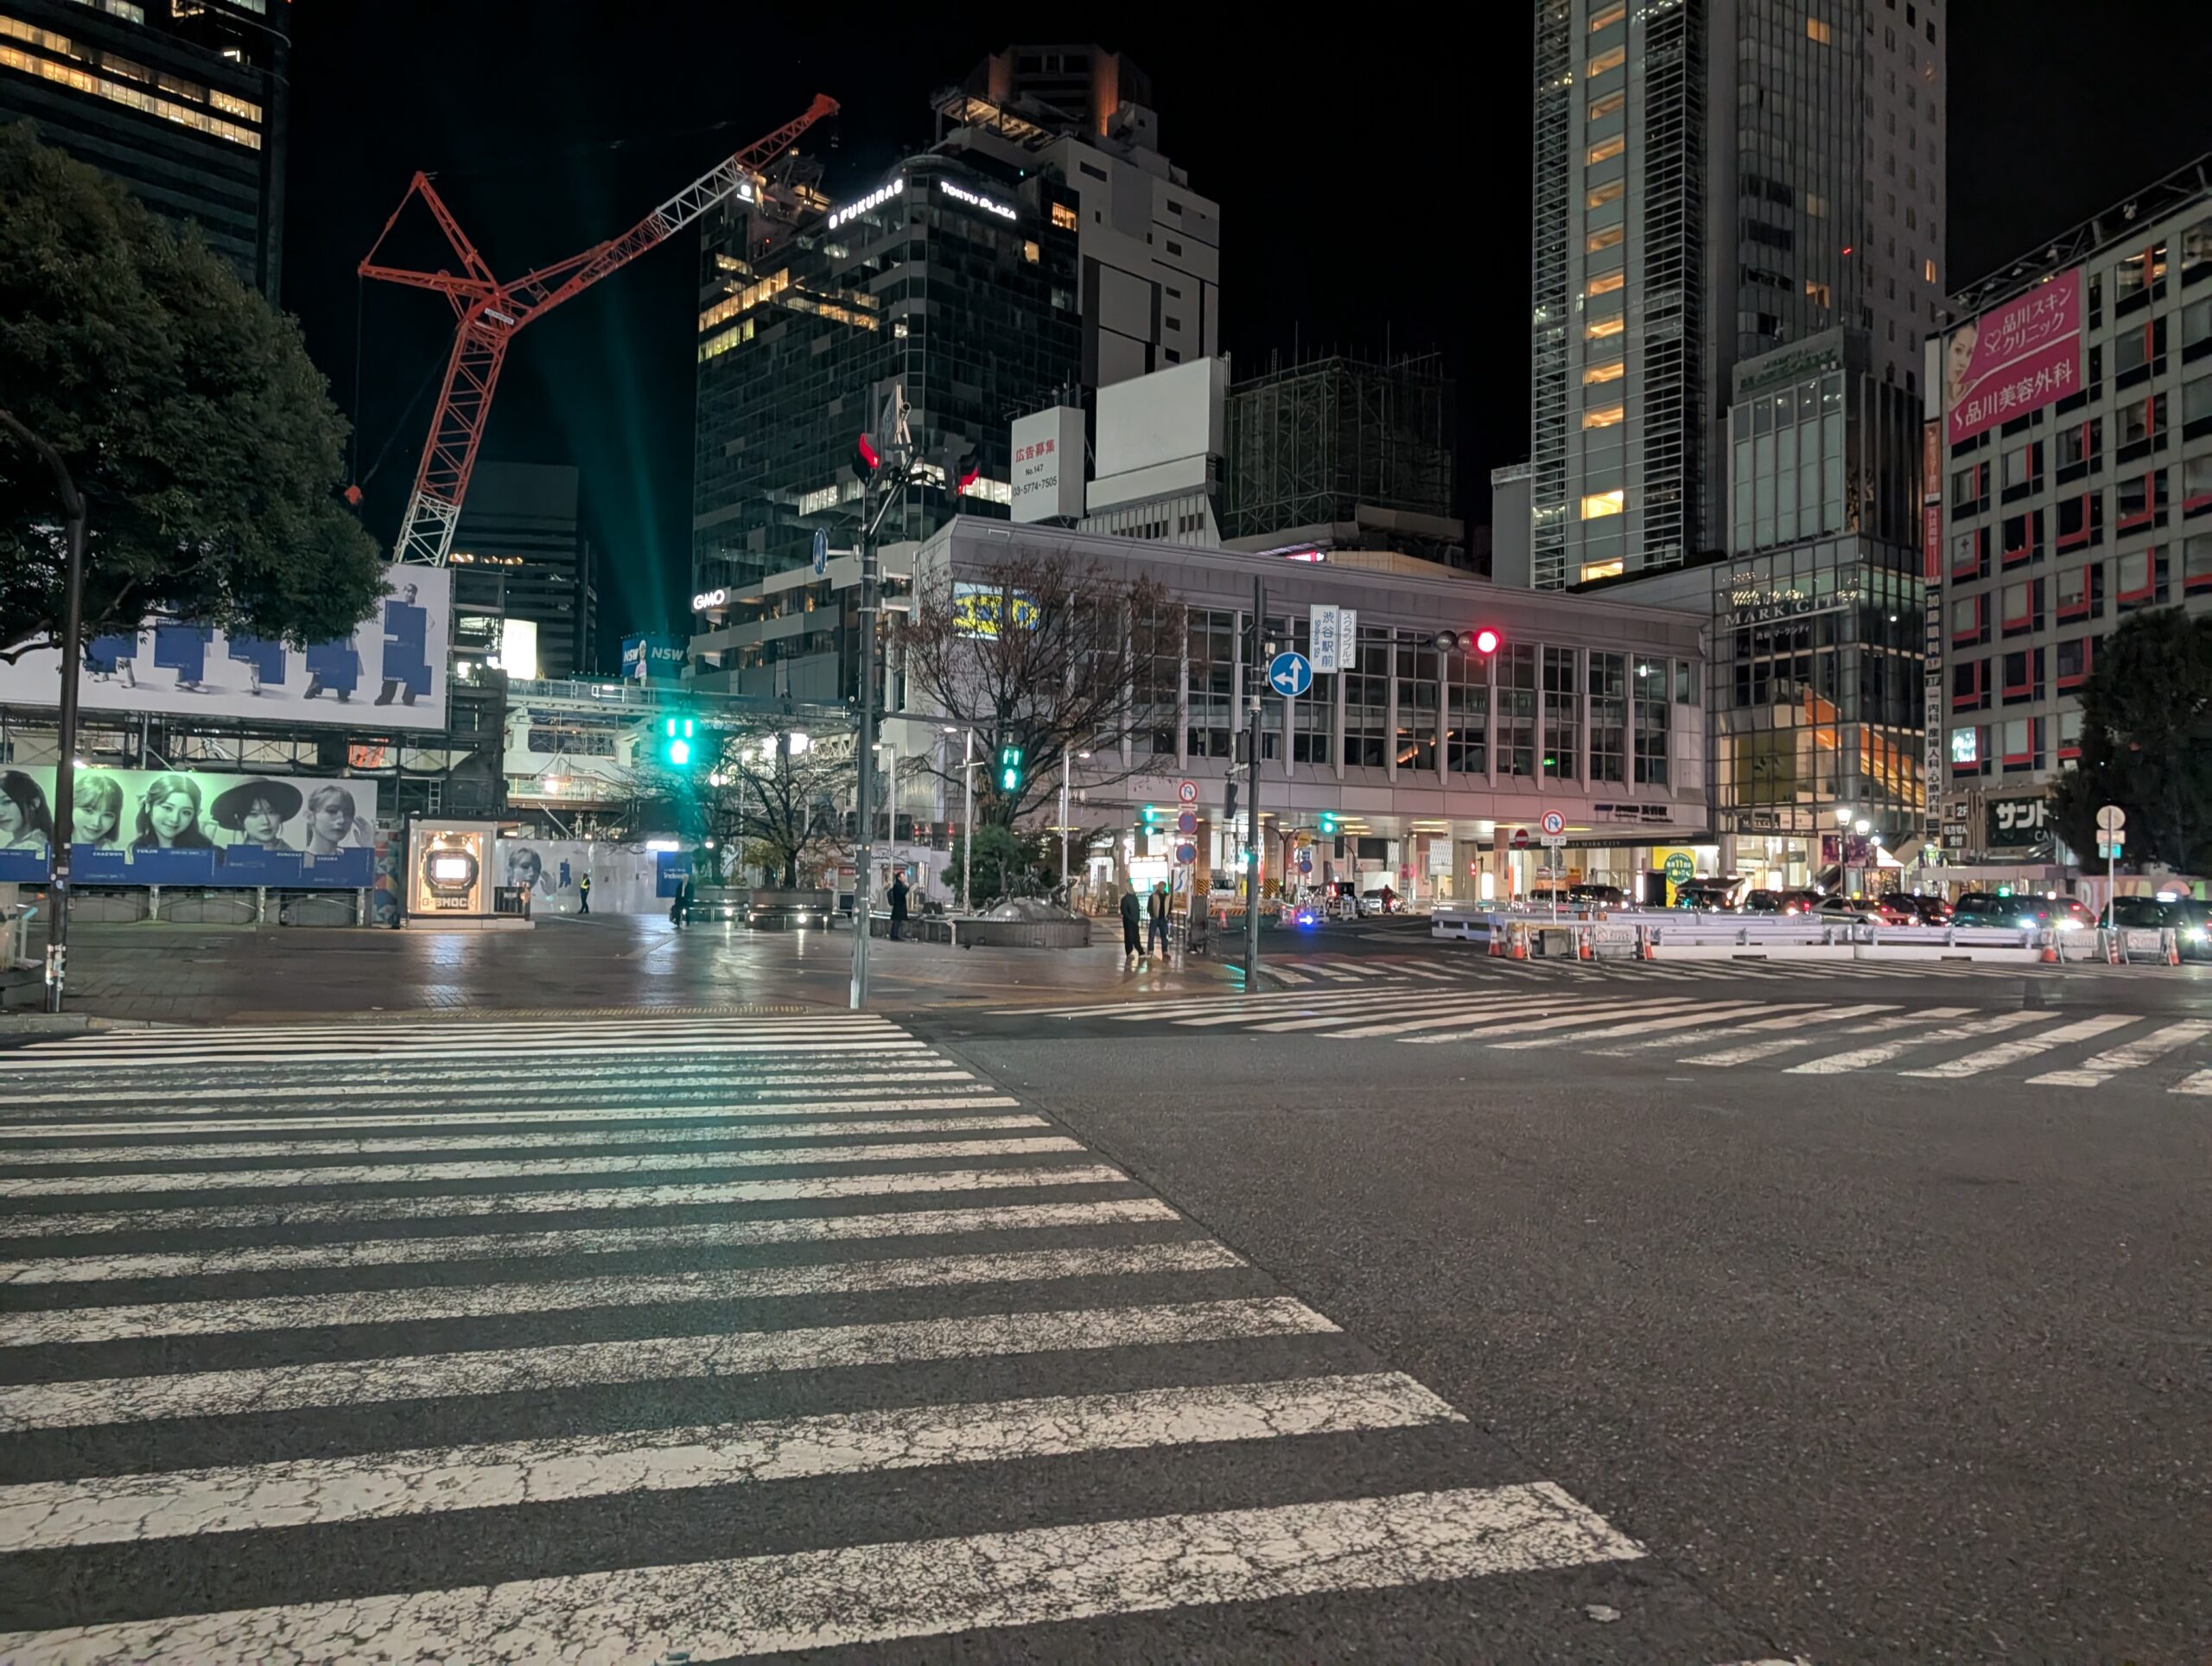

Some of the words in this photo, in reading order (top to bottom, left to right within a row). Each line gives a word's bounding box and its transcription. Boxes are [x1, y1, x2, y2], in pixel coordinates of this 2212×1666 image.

[839, 178, 904, 225] FUKURAS
[940, 181, 978, 205] TOKYU
[979, 198, 1017, 220] PLAZA
[2002, 287, 2073, 336] 品川スキン
[2003, 312, 2065, 357] クリニック
[1965, 358, 2073, 427] 品川美容外科
[1014, 437, 1056, 464] 広告募集
[693, 588, 726, 610] GMO
[1725, 605, 1786, 627] MARK
[623, 647, 639, 663] NSW
[650, 646, 685, 661] NSW
[1321, 610, 1334, 668] 渋谷駅前
[1342, 612, 1352, 666] スクランブル式
[1956, 804, 1968, 817] 2F
